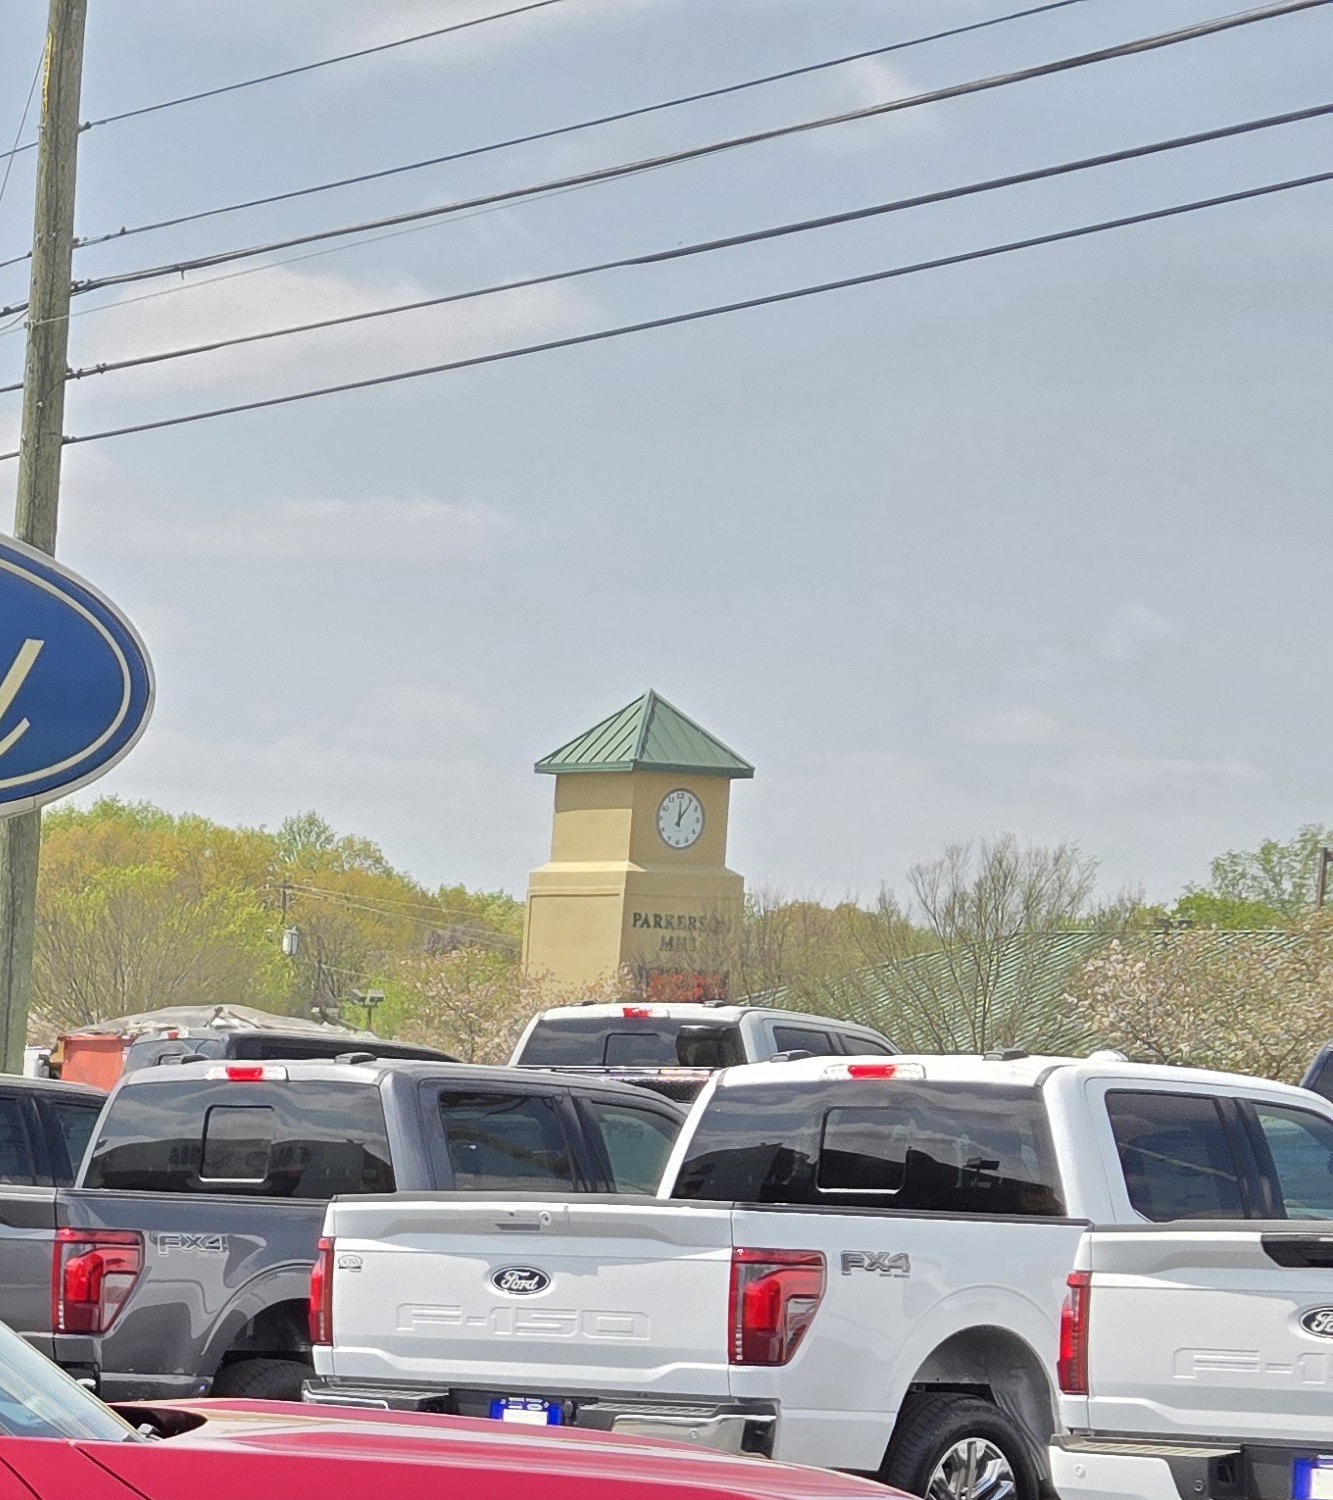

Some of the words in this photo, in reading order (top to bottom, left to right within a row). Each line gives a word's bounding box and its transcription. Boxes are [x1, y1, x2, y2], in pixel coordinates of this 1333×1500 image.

[157, 1232, 229, 1257] FX4
[840, 1250, 912, 1276] FX4
[501, 1270, 540, 1290] Ford
[396, 1302, 651, 1341] F-150
[1172, 1347, 1333, 1385] F-1
